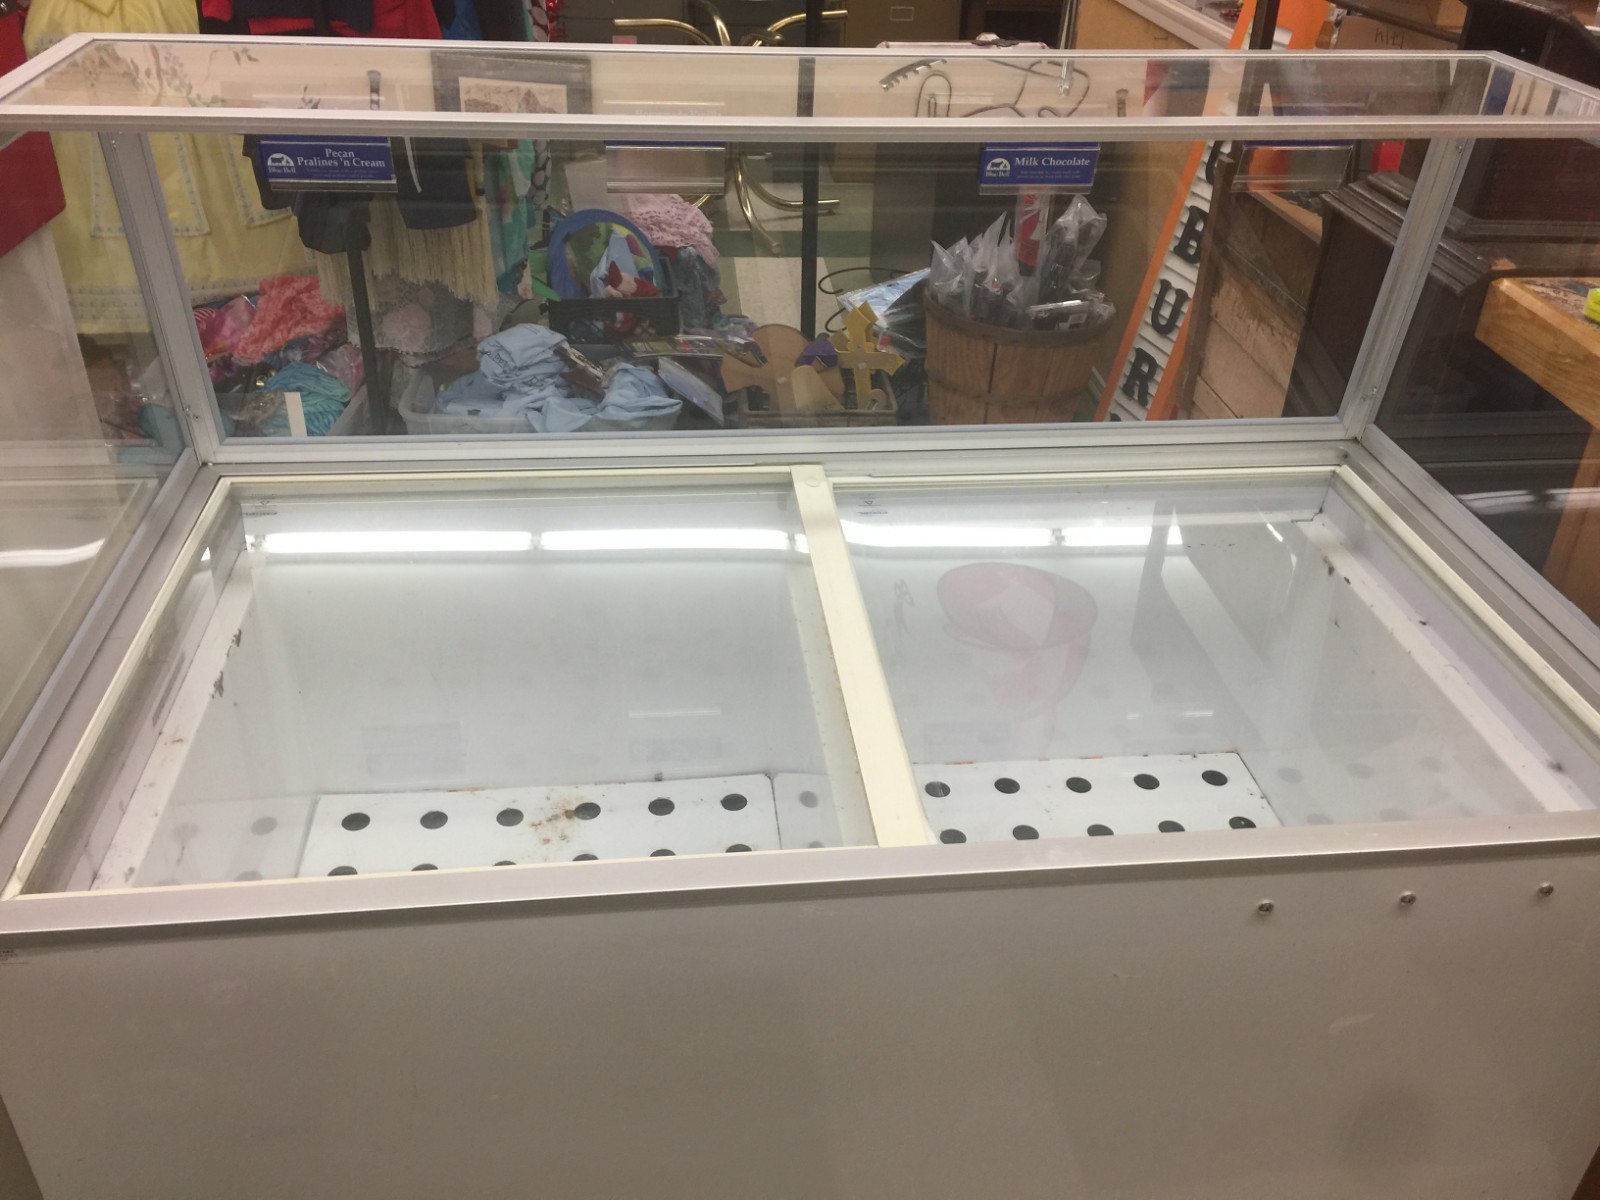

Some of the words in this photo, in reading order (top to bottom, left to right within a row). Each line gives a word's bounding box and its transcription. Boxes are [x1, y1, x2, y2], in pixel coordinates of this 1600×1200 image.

[325, 148, 355, 158] Pecan
[297, 156, 339, 167] Pralines
[340, 157, 350, 167] 'n
[352, 158, 386, 168] Cream
[1014, 157, 1039, 166] Milk
[1041, 157, 1090, 166] Chocolate
